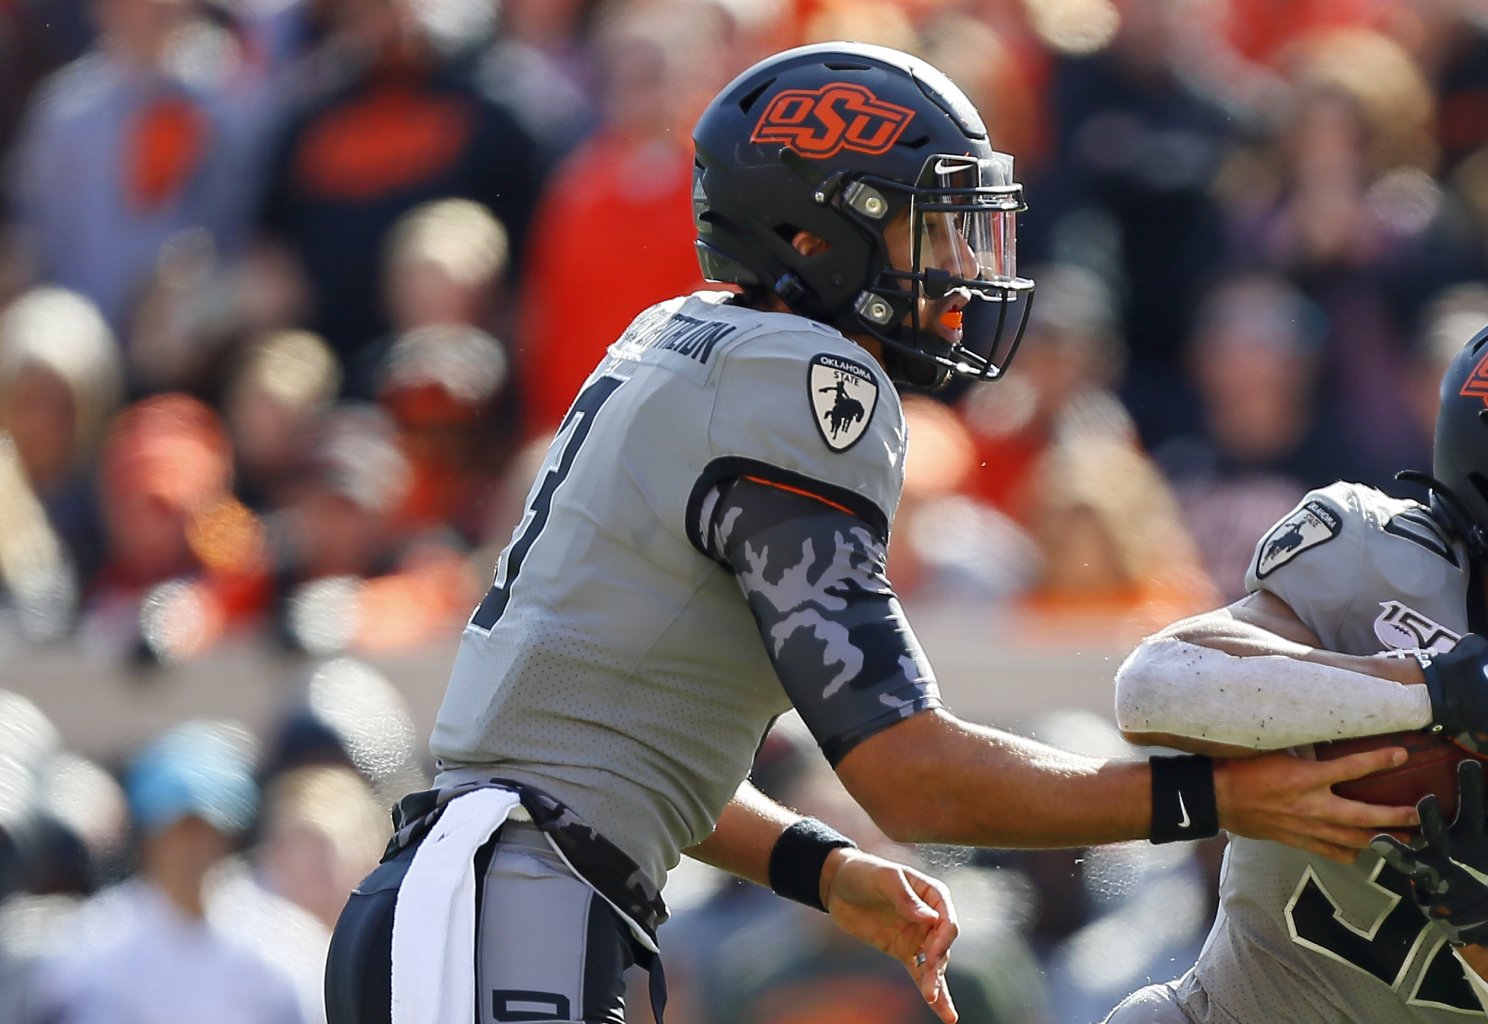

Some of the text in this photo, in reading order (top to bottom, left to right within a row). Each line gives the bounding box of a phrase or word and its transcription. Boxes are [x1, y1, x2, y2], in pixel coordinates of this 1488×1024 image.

[750, 82, 917, 160] OSU
[820, 357, 872, 381] OKLAHOMA
[833, 370, 861, 387] STATE
